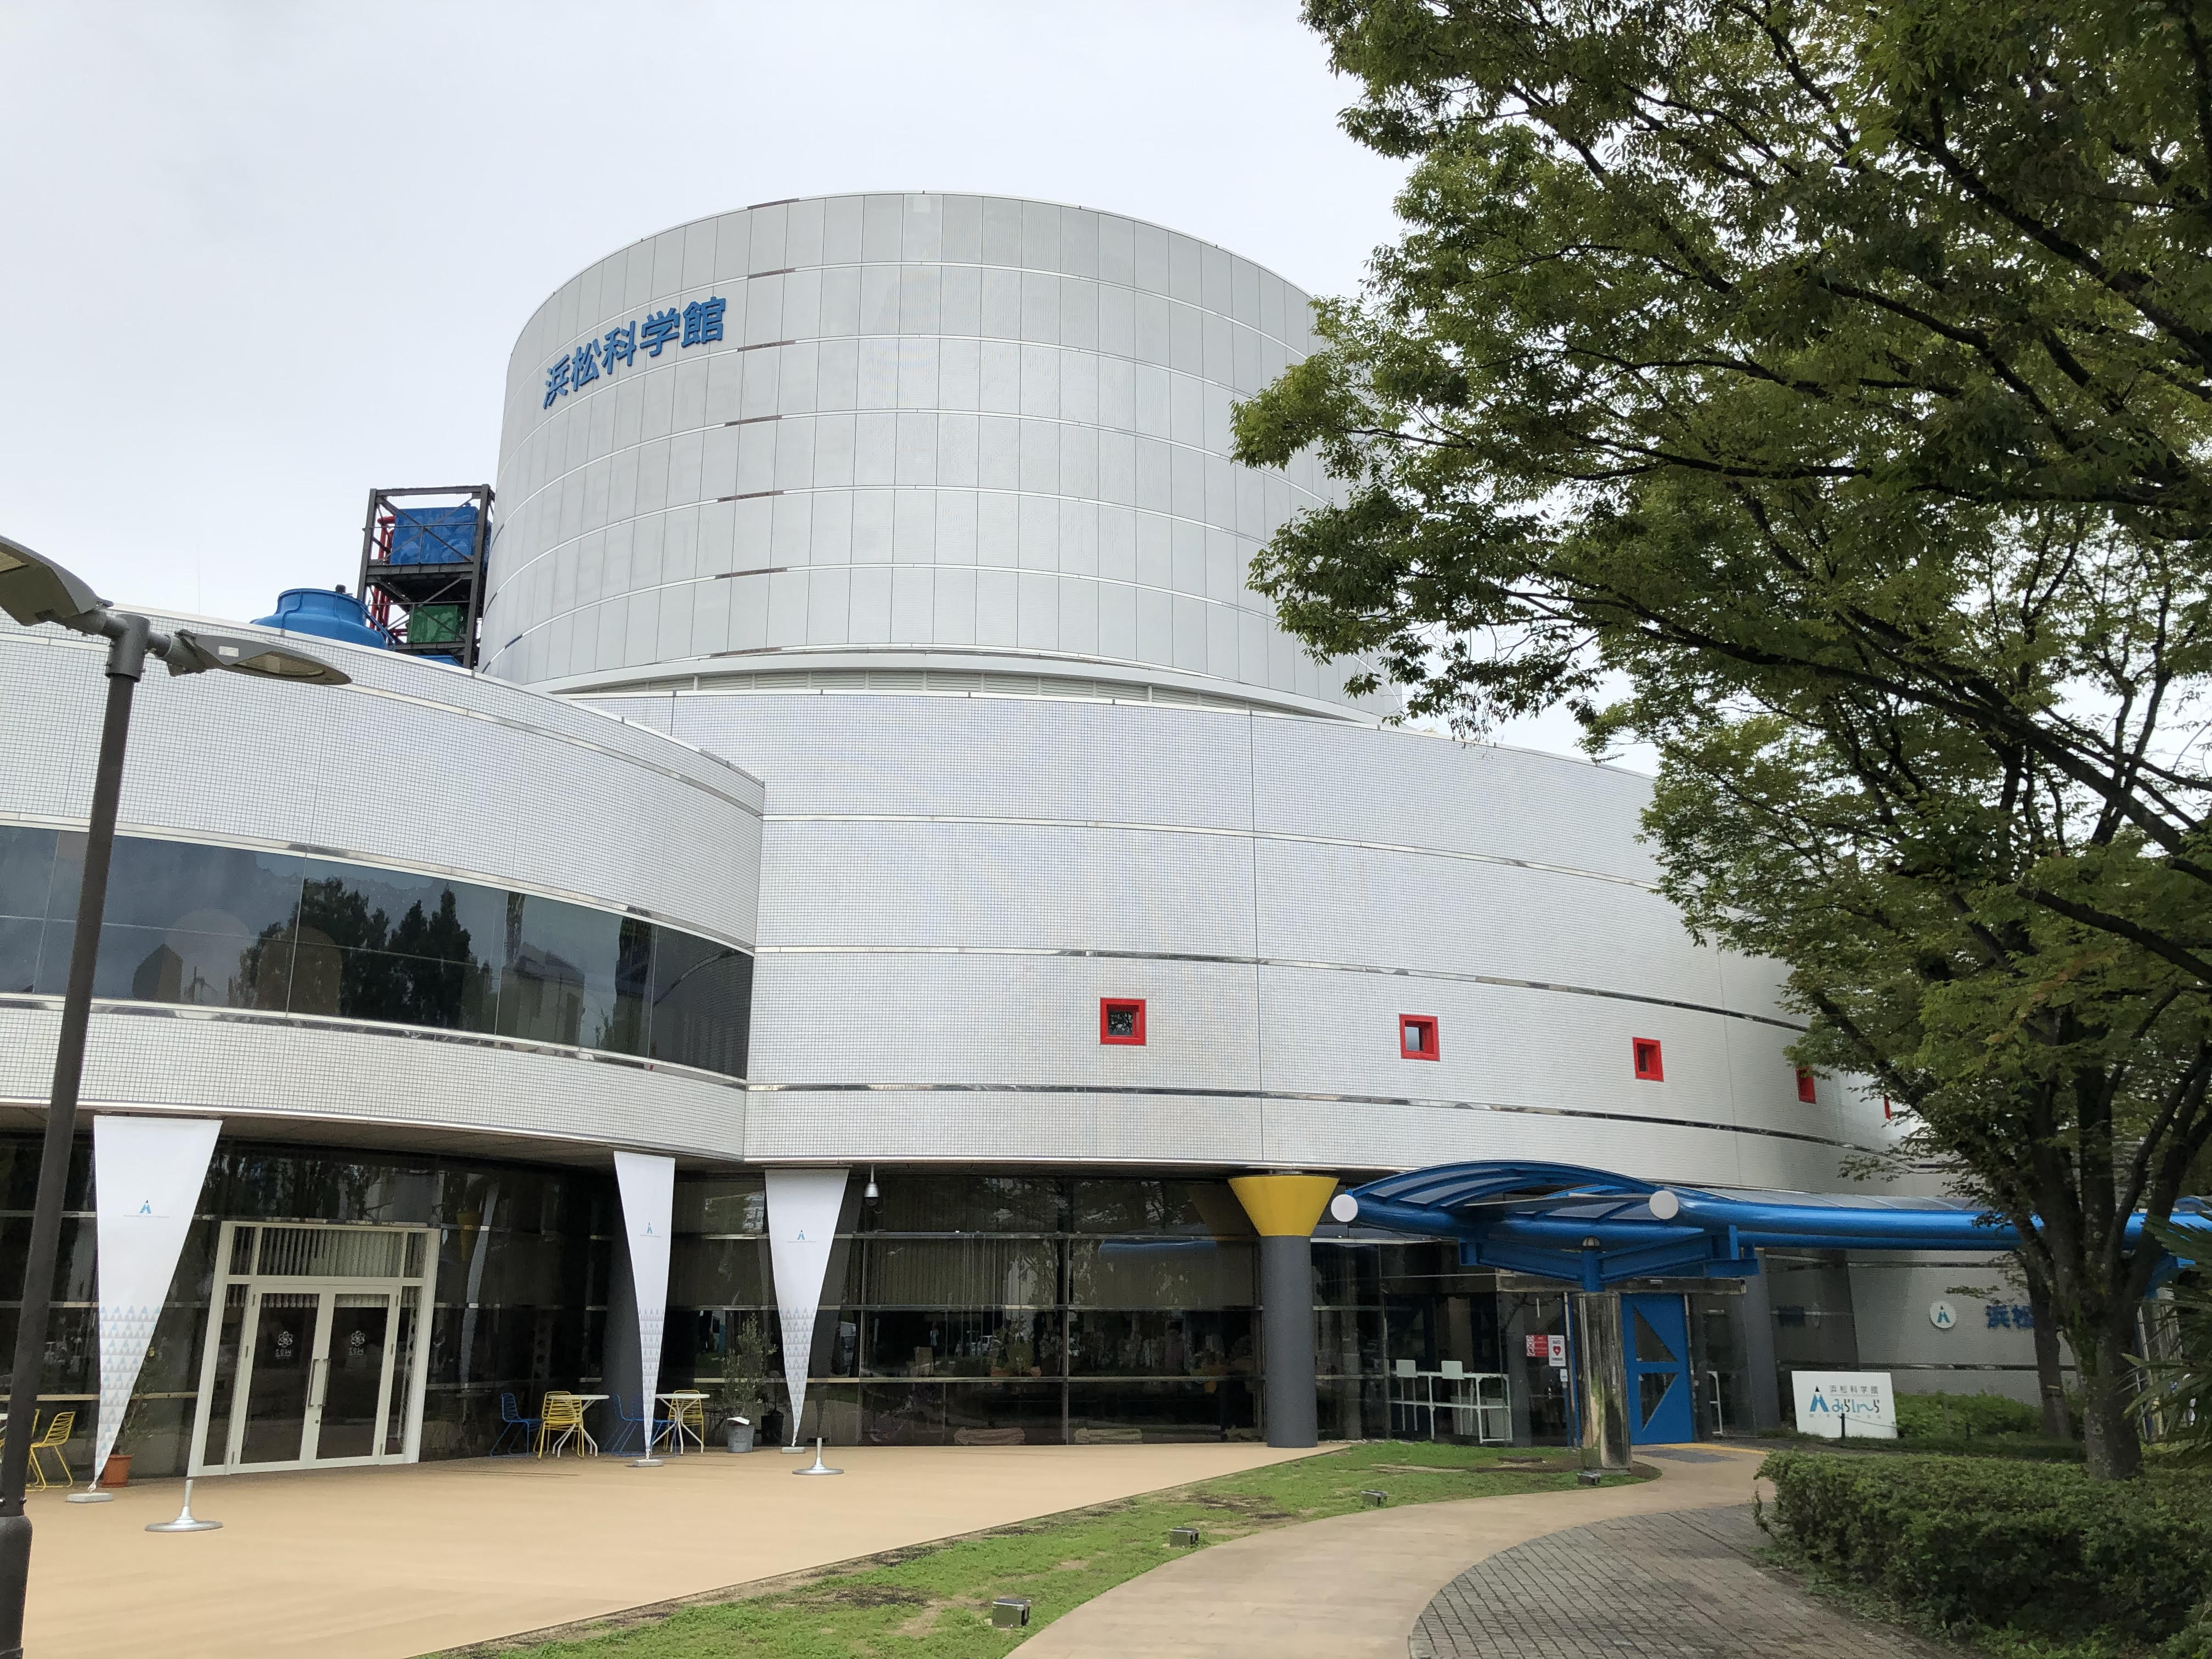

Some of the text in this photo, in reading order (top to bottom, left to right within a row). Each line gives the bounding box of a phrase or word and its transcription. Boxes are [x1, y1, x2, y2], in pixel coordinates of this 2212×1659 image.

[543, 296, 726, 409] 浜松科学館
